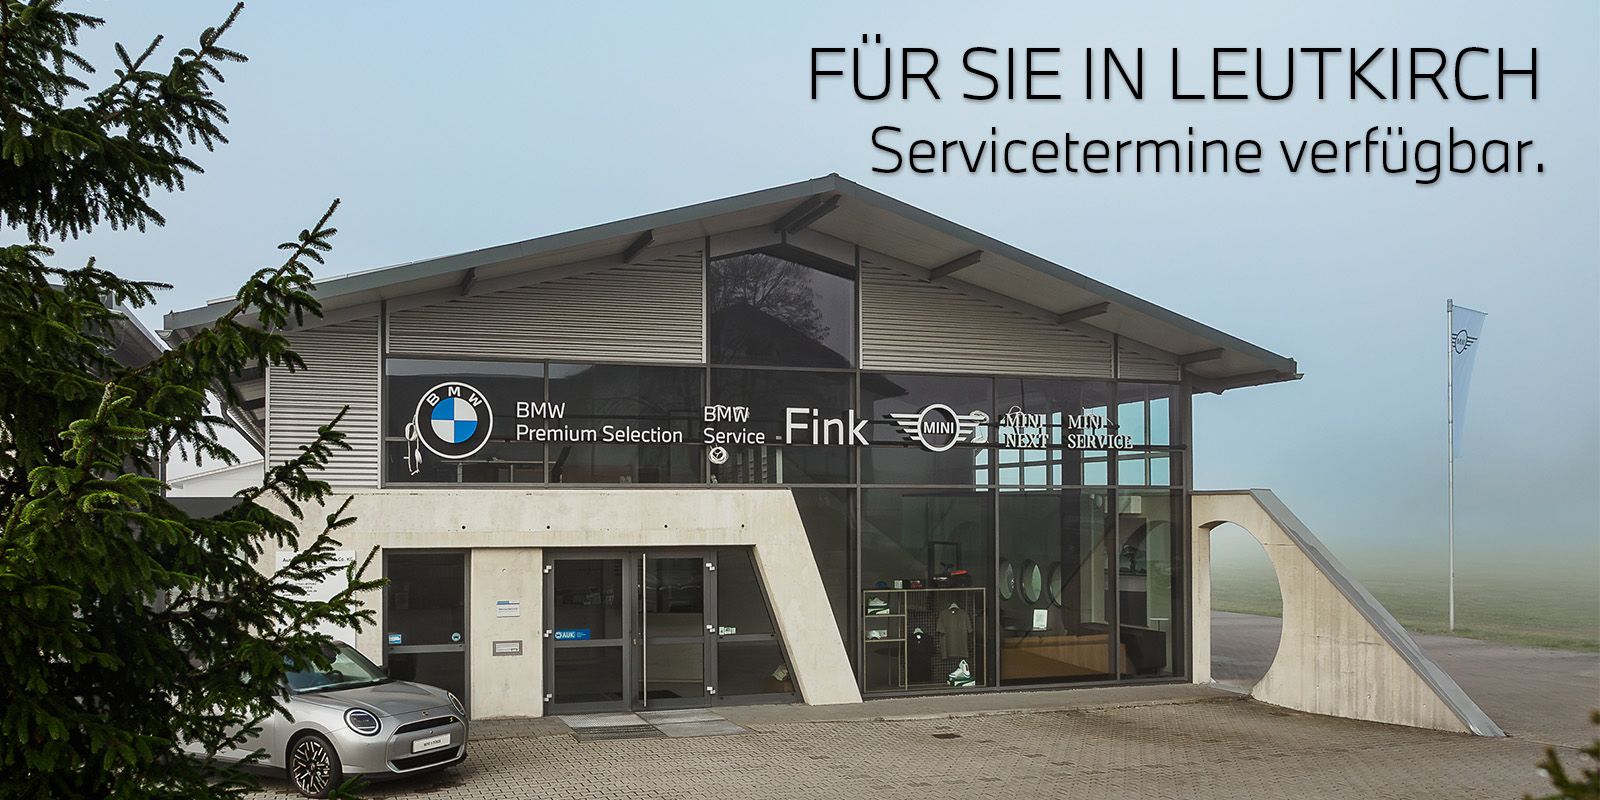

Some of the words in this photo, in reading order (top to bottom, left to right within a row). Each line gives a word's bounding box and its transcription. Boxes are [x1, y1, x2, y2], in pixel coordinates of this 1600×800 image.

[426, 386, 482, 407] BMW
[516, 402, 566, 419] BMW
[703, 406, 749, 423] BMW
[785, 407, 869, 446] Fink
[923, 421, 954, 434] MINI
[1004, 413, 1044, 428] MINI
[1067, 414, 1104, 429] MINI
[516, 424, 597, 442] Premium
[602, 425, 683, 443] Selection
[703, 428, 765, 444] Service
[1005, 434, 1049, 448] NEXT
[1067, 434, 1134, 449] SERVICE
